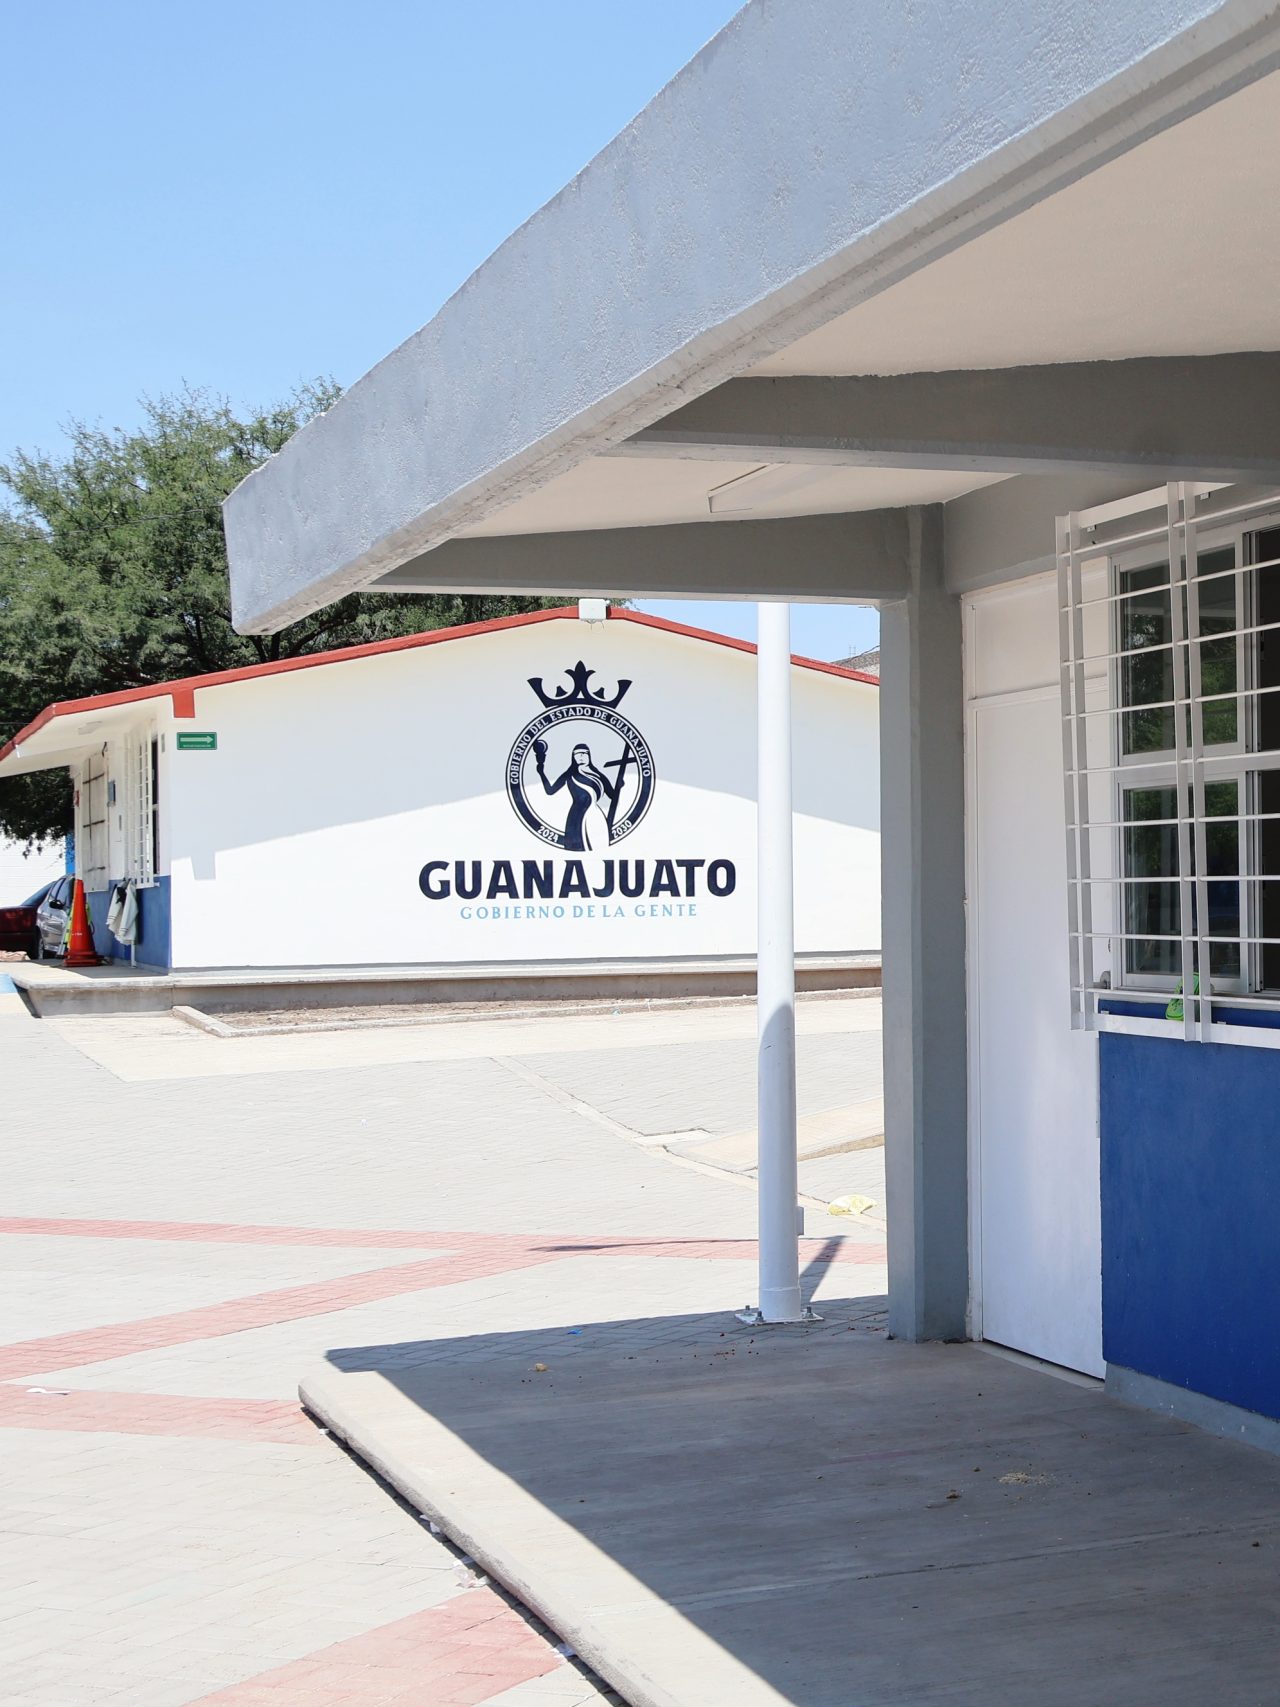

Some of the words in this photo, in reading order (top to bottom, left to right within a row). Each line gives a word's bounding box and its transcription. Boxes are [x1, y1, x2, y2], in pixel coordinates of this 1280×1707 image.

[511, 734, 532, 784] GOBIERNO
[530, 718, 549, 735] DEL
[550, 707, 591, 722] ESTADO
[594, 709, 608, 721] DE
[609, 717, 651, 777] GUANAJUATO
[537, 825, 559, 843] 2024
[611, 819, 633, 839] 2030
[418, 859, 737, 900] GUANAJUATO
[460, 905, 565, 920] GOBIERNO
[572, 905, 596, 919] DE
[602, 904, 626, 918] LA
[634, 904, 697, 918] GENTE
